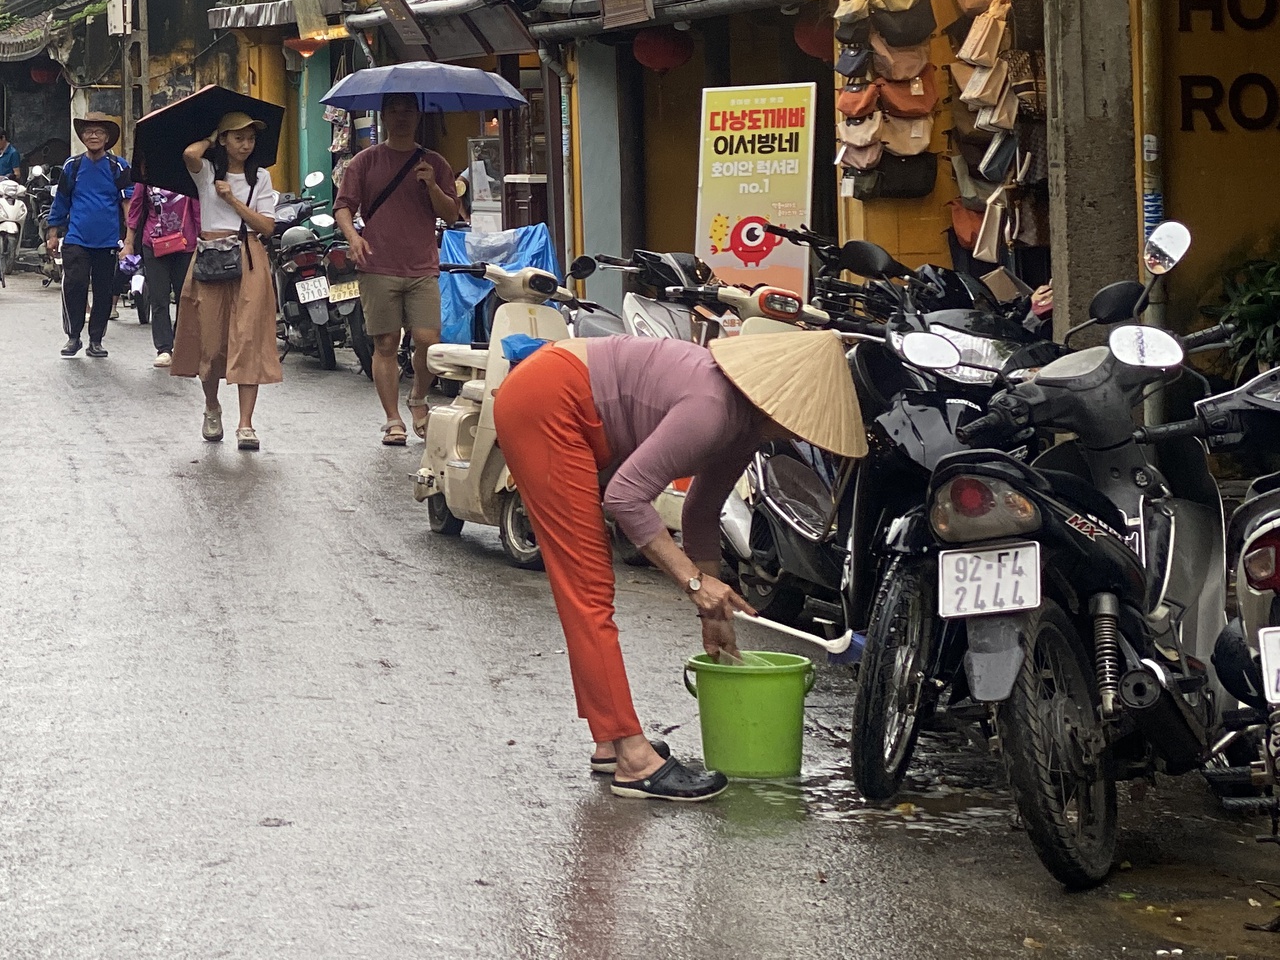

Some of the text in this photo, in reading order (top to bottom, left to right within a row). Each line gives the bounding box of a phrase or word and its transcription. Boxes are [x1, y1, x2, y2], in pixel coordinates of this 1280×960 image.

[1179, 72, 1280, 132] RO
[709, 107, 806, 132] 다낭도깨비
[713, 132, 800, 156] 이서방네
[711, 159, 799, 178] 호이안 럭셔리
[739, 178, 770, 194] no.1
[300, 288, 328, 301] 371.03
[946, 398, 982, 412] HONDA
[1065, 513, 1108, 542] MX
[954, 551, 1025, 583] 92-F4
[955, 581, 1024, 612] 2444
